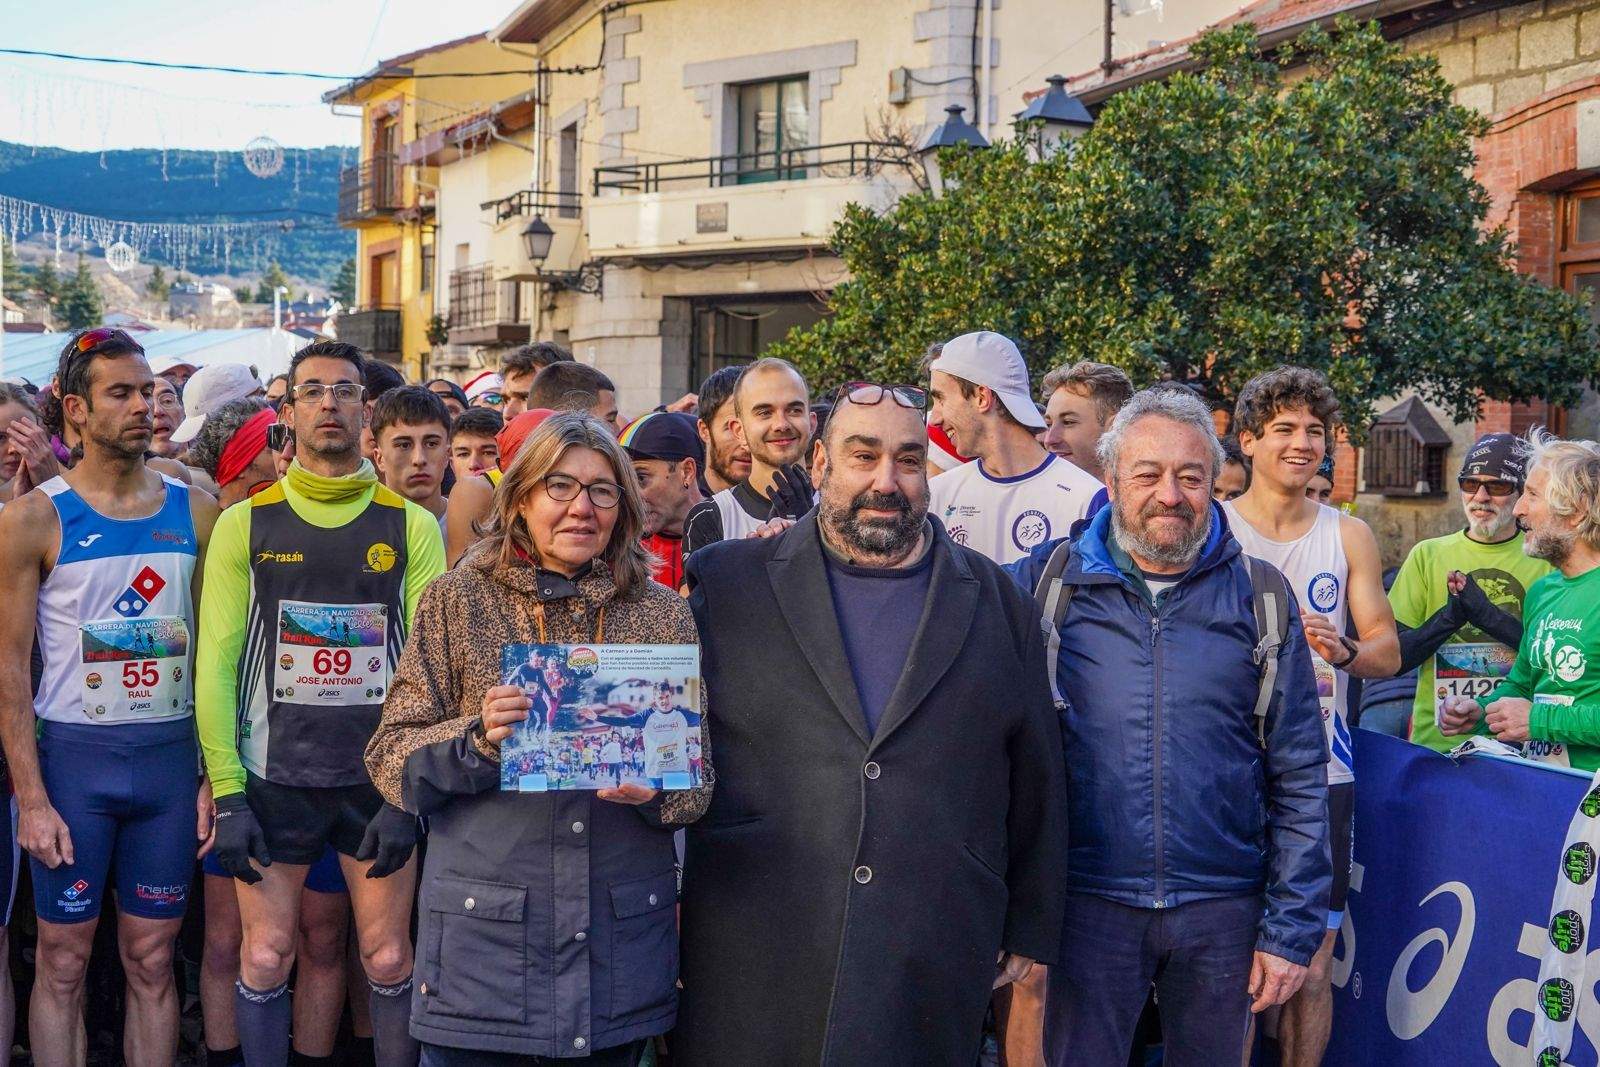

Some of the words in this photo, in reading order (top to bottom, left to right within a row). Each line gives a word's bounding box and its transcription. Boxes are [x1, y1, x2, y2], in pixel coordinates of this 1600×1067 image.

[286, 605, 319, 615] CARRERA
[122, 660, 160, 689] 55
[312, 648, 352, 675] 69
[128, 690, 152, 699] RAUL
[296, 676, 320, 684] JOSE
[321, 677, 363, 685] ANTONIO
[1553, 916, 1571, 952] Life
[1568, 912, 1580, 948] Sport
[1544, 984, 1562, 1020] Life
[1560, 978, 1572, 1016] Sport
